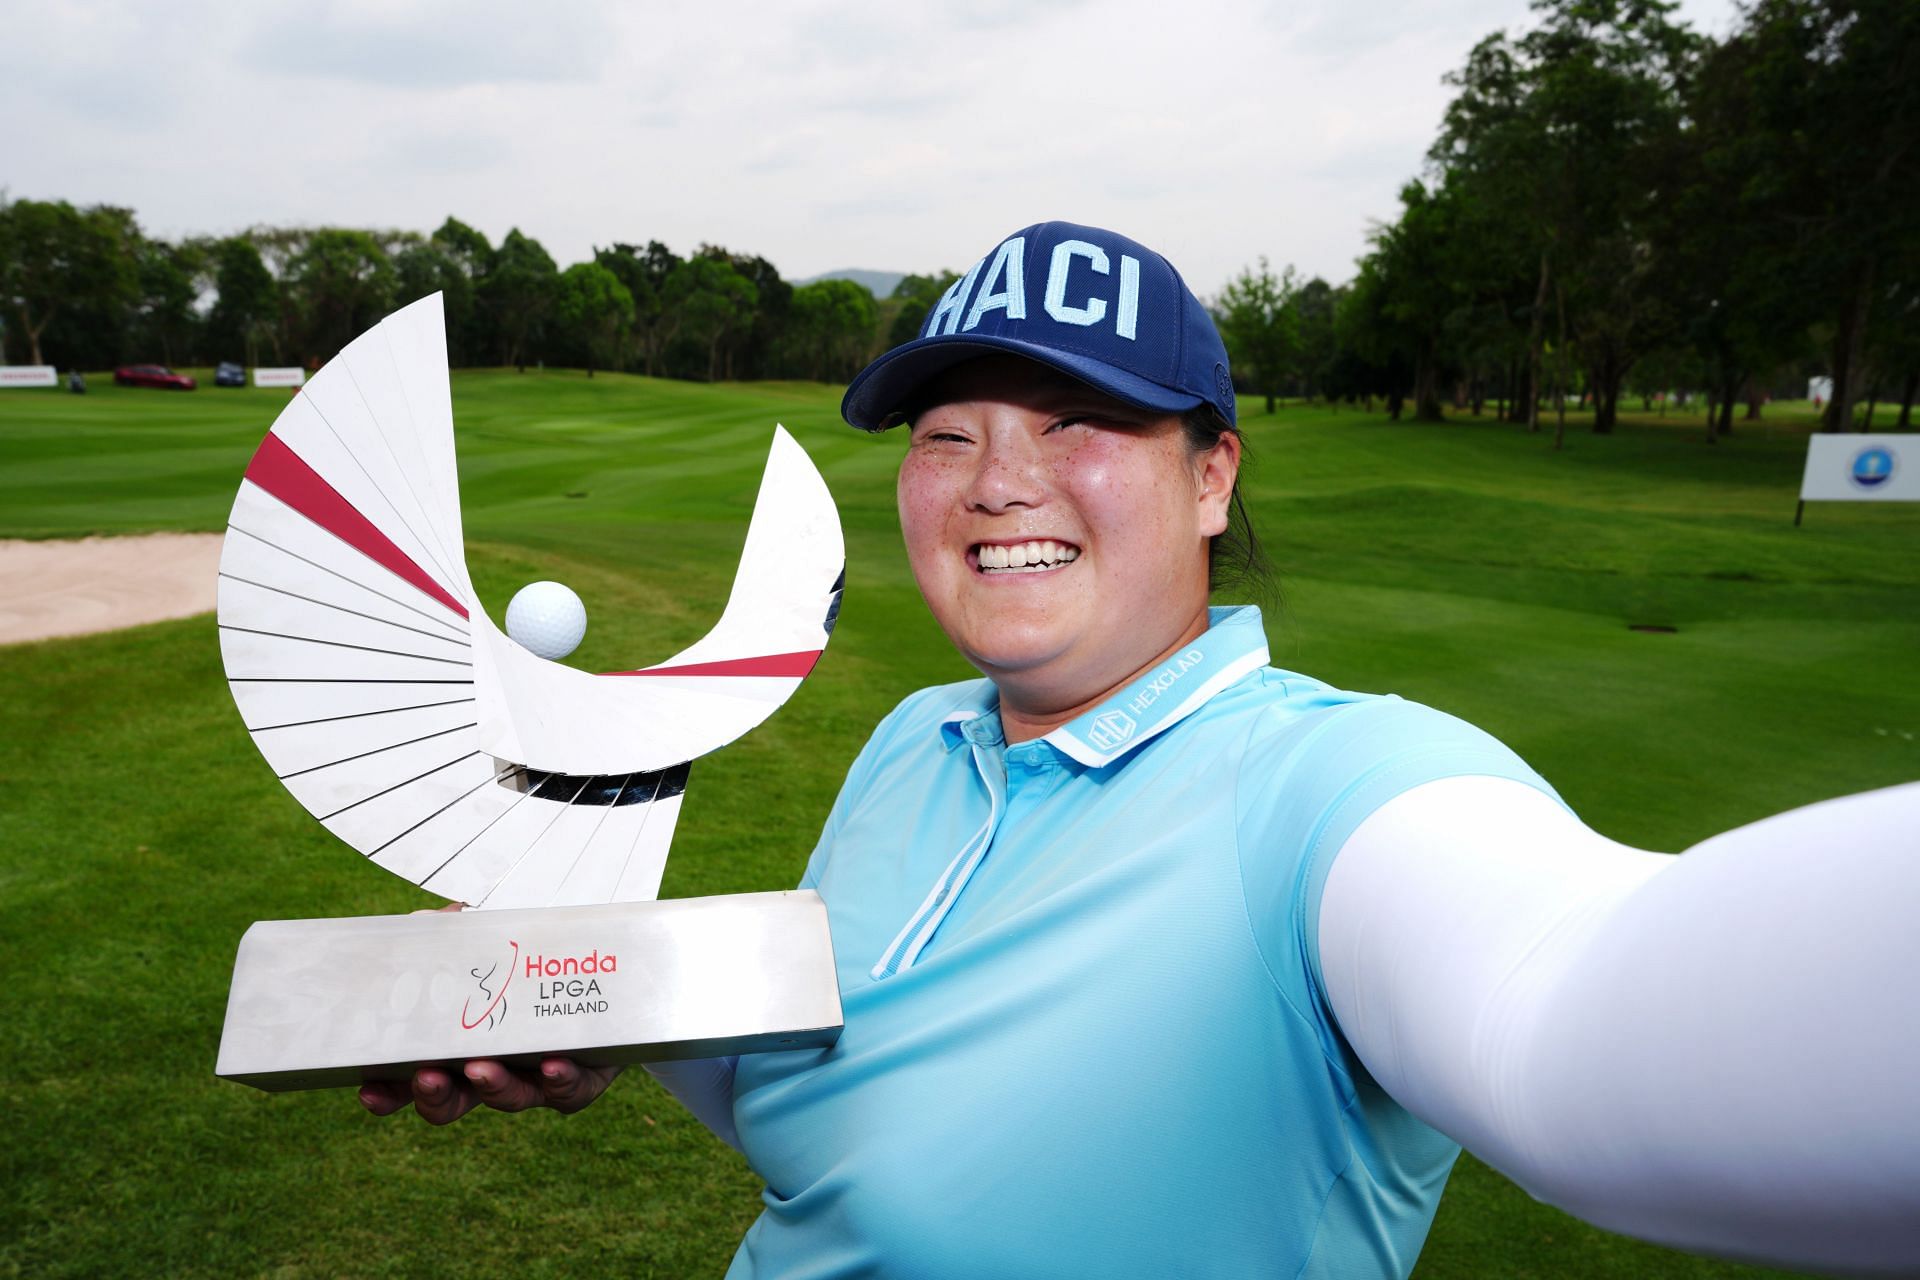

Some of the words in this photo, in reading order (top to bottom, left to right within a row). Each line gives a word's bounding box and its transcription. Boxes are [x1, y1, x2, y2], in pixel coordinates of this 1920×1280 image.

[925, 236, 1140, 341] HACI
[1129, 649, 1204, 715] HEXCLAD
[525, 949, 617, 978] Honda
[539, 978, 602, 1000] LPGA
[533, 1000, 609, 1018] THAILAND
